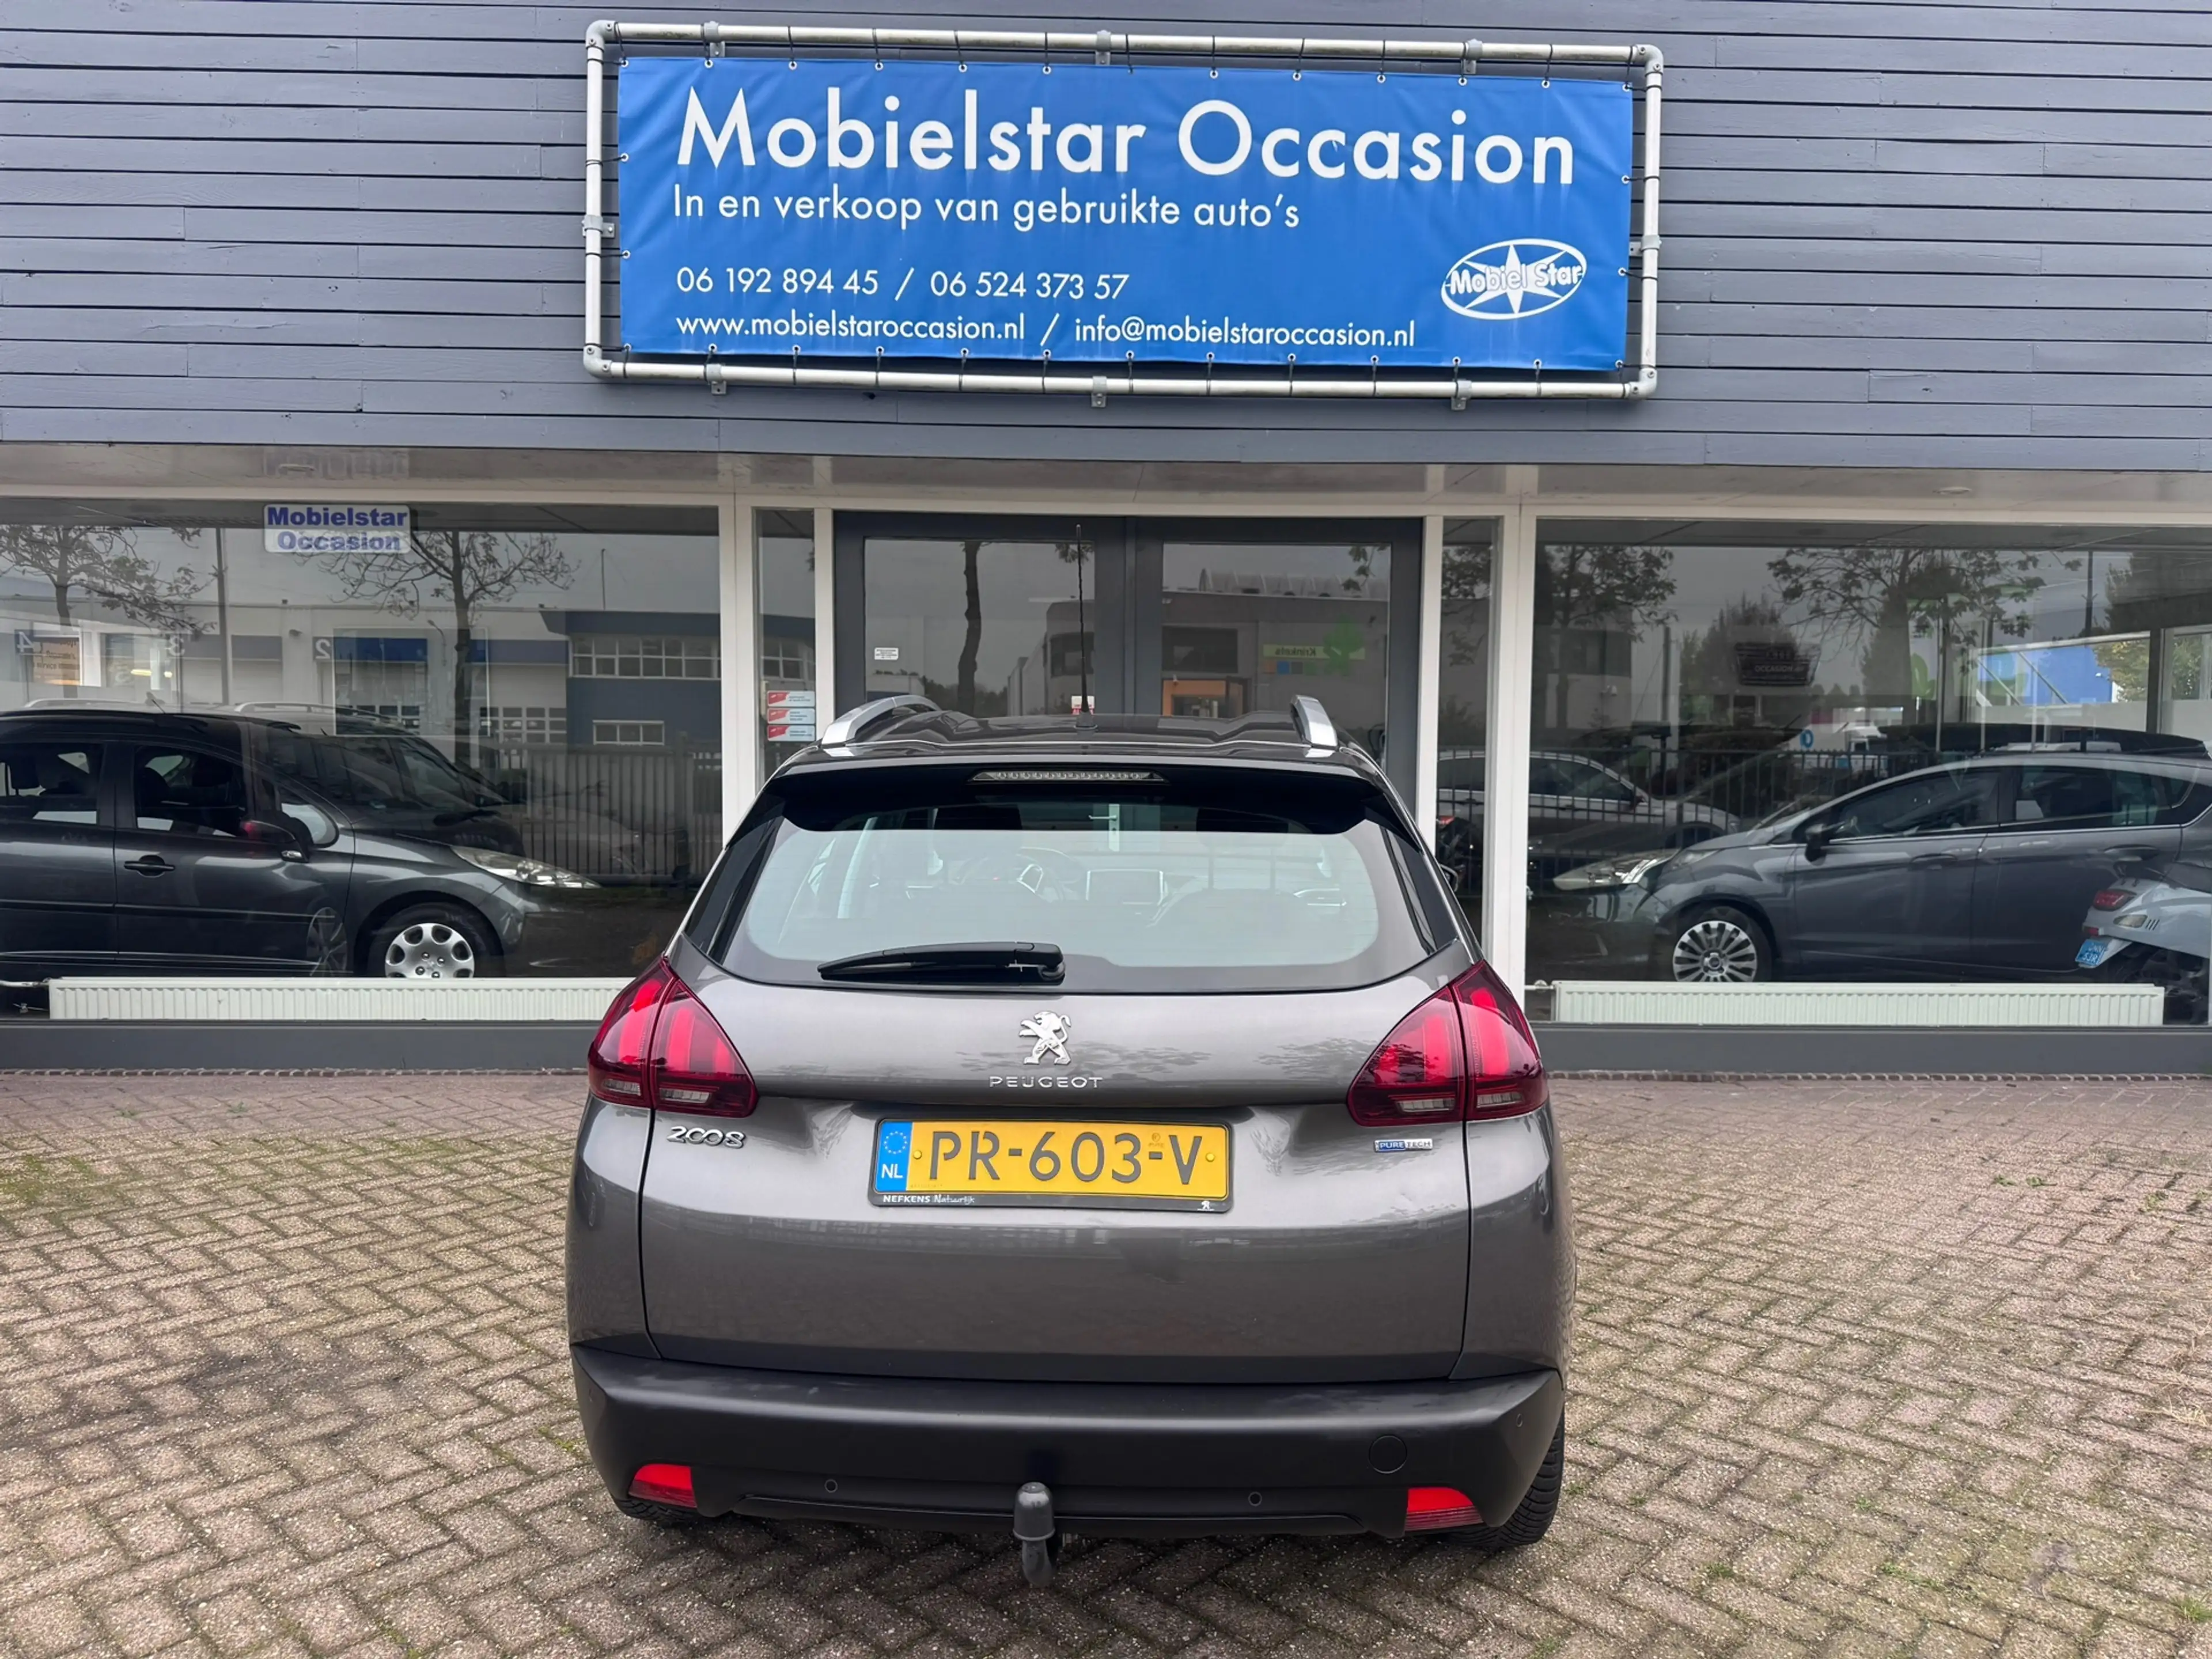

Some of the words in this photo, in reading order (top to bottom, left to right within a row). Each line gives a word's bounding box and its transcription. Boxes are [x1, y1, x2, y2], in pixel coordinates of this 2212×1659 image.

[678, 87, 1146, 172] Mobielstar
[1179, 100, 1572, 184] Occasion
[675, 184, 702, 216] In
[719, 196, 759, 217] en
[774, 184, 921, 230] verkoop
[935, 199, 997, 221] van
[1014, 188, 1179, 232] gebruikte
[1195, 194, 1298, 227] auto's
[677, 267, 713, 291] 06
[727, 268, 771, 292] 192
[783, 269, 834, 293] 894
[843, 270, 877, 294] 45
[895, 268, 914, 300] /
[931, 271, 966, 296] 06
[976, 272, 1026, 296] 524
[1037, 273, 1083, 299] 373
[1095, 275, 1129, 299] 57
[1450, 263, 1528, 294] Mobiel
[1533, 263, 1581, 286] Star
[677, 309, 1024, 339] www.mobielstaroccasion.nl
[1041, 314, 1059, 346] /
[1075, 315, 1414, 347] info@mobielstaroccasion.nl
[267, 507, 407, 526] Mobielstar
[278, 531, 400, 550] Occasion
[990, 1076, 1103, 1088] PEUGEOT
[667, 1126, 746, 1149] 2008
[930, 1130, 1203, 1185] PR-603-V
[881, 1164, 903, 1179] NL
[883, 1195, 930, 1203] NEFKENS
